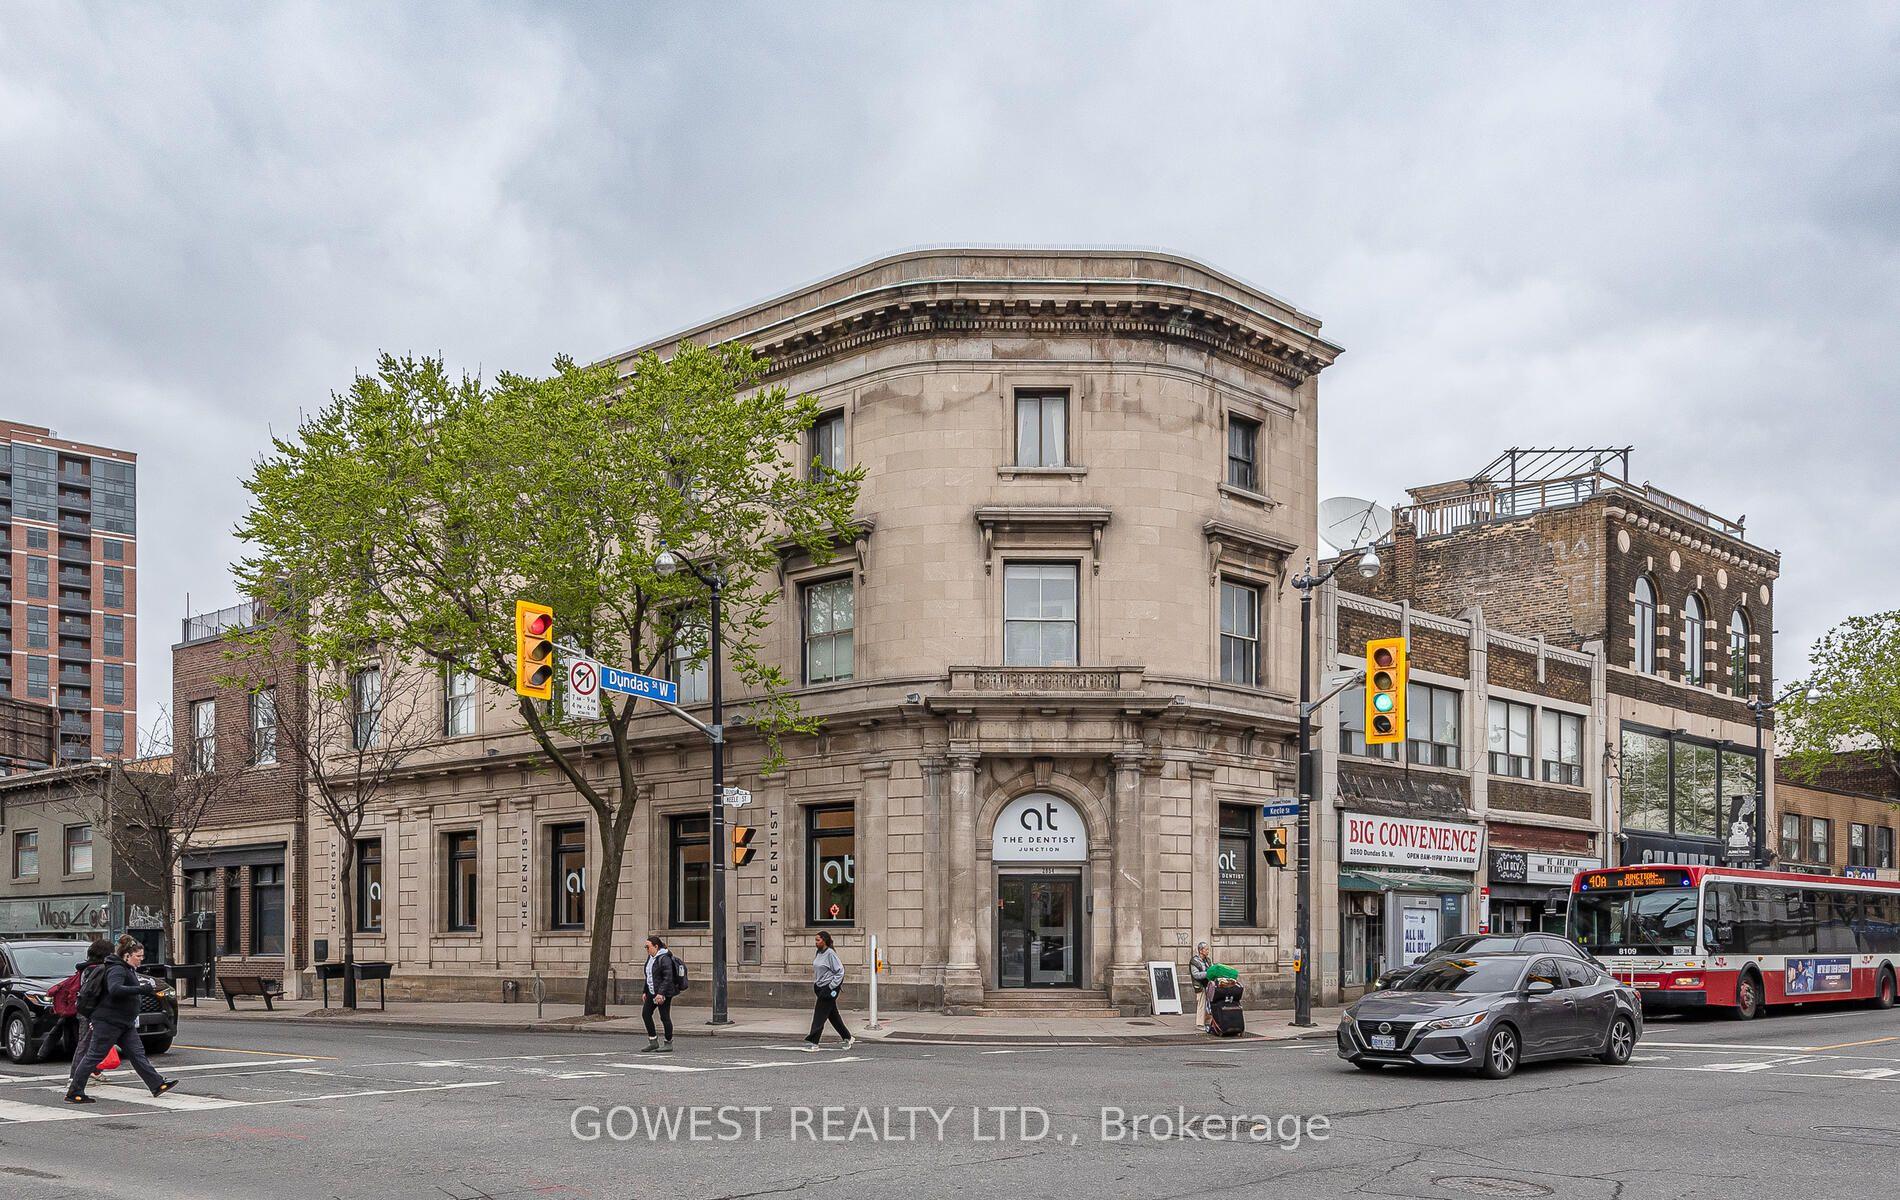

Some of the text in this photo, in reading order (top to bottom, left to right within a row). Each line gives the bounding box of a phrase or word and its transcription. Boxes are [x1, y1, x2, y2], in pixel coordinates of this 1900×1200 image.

[609, 670, 669, 697] Dundas St W
[1269, 806, 1285, 815] Keele
[1020, 803, 1058, 831] at
[1349, 819, 1477, 853] BIG CONVENIENCE
[1350, 848, 1363, 856] 2850
[1364, 849, 1381, 857] Dundas
[1406, 852, 1419, 860] OPEN
[770, 810, 778, 926] THE DENTIST
[1589, 875, 1607, 888] 40A
[1405, 929, 1425, 940] ALL IN.
[1405, 942, 1416, 953] ALL
[1618, 947, 1637, 955] 8109
